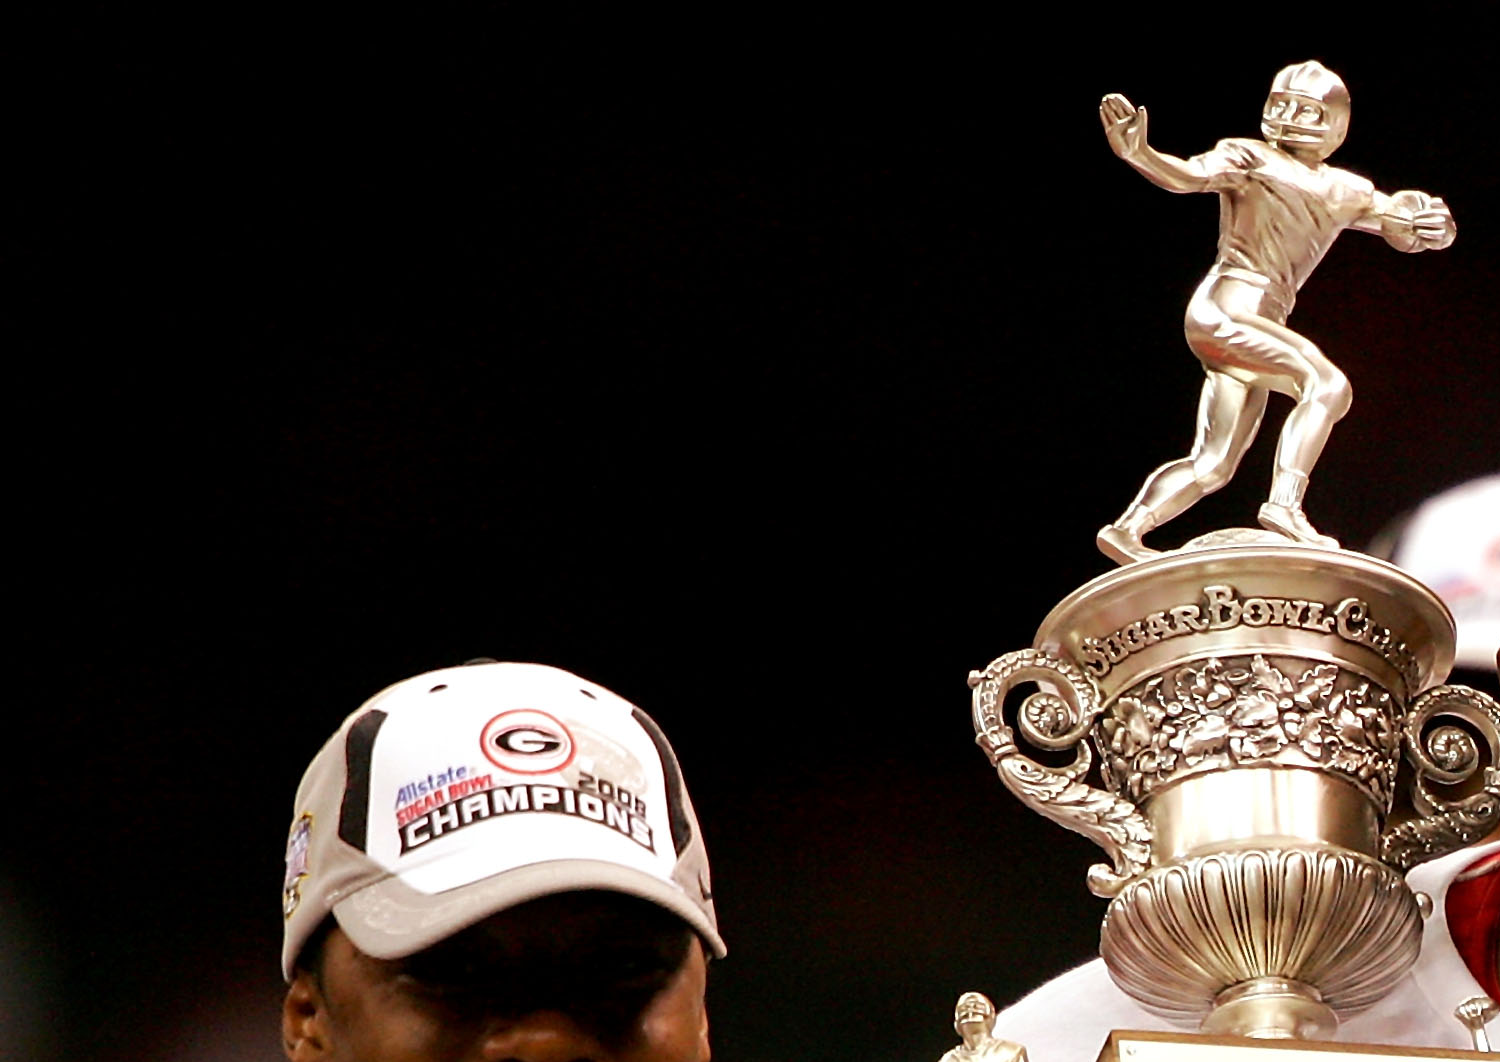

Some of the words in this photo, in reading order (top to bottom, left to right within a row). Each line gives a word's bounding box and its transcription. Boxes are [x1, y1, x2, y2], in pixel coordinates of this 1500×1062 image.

[1081, 604, 1209, 677] SUGAR
[1203, 584, 1336, 633] BOWL
[395, 766, 467, 810] Allstate
[396, 788, 444, 827] SUGAR
[578, 771, 647, 821] 2008
[405, 786, 652, 849] CHAMPIONS
